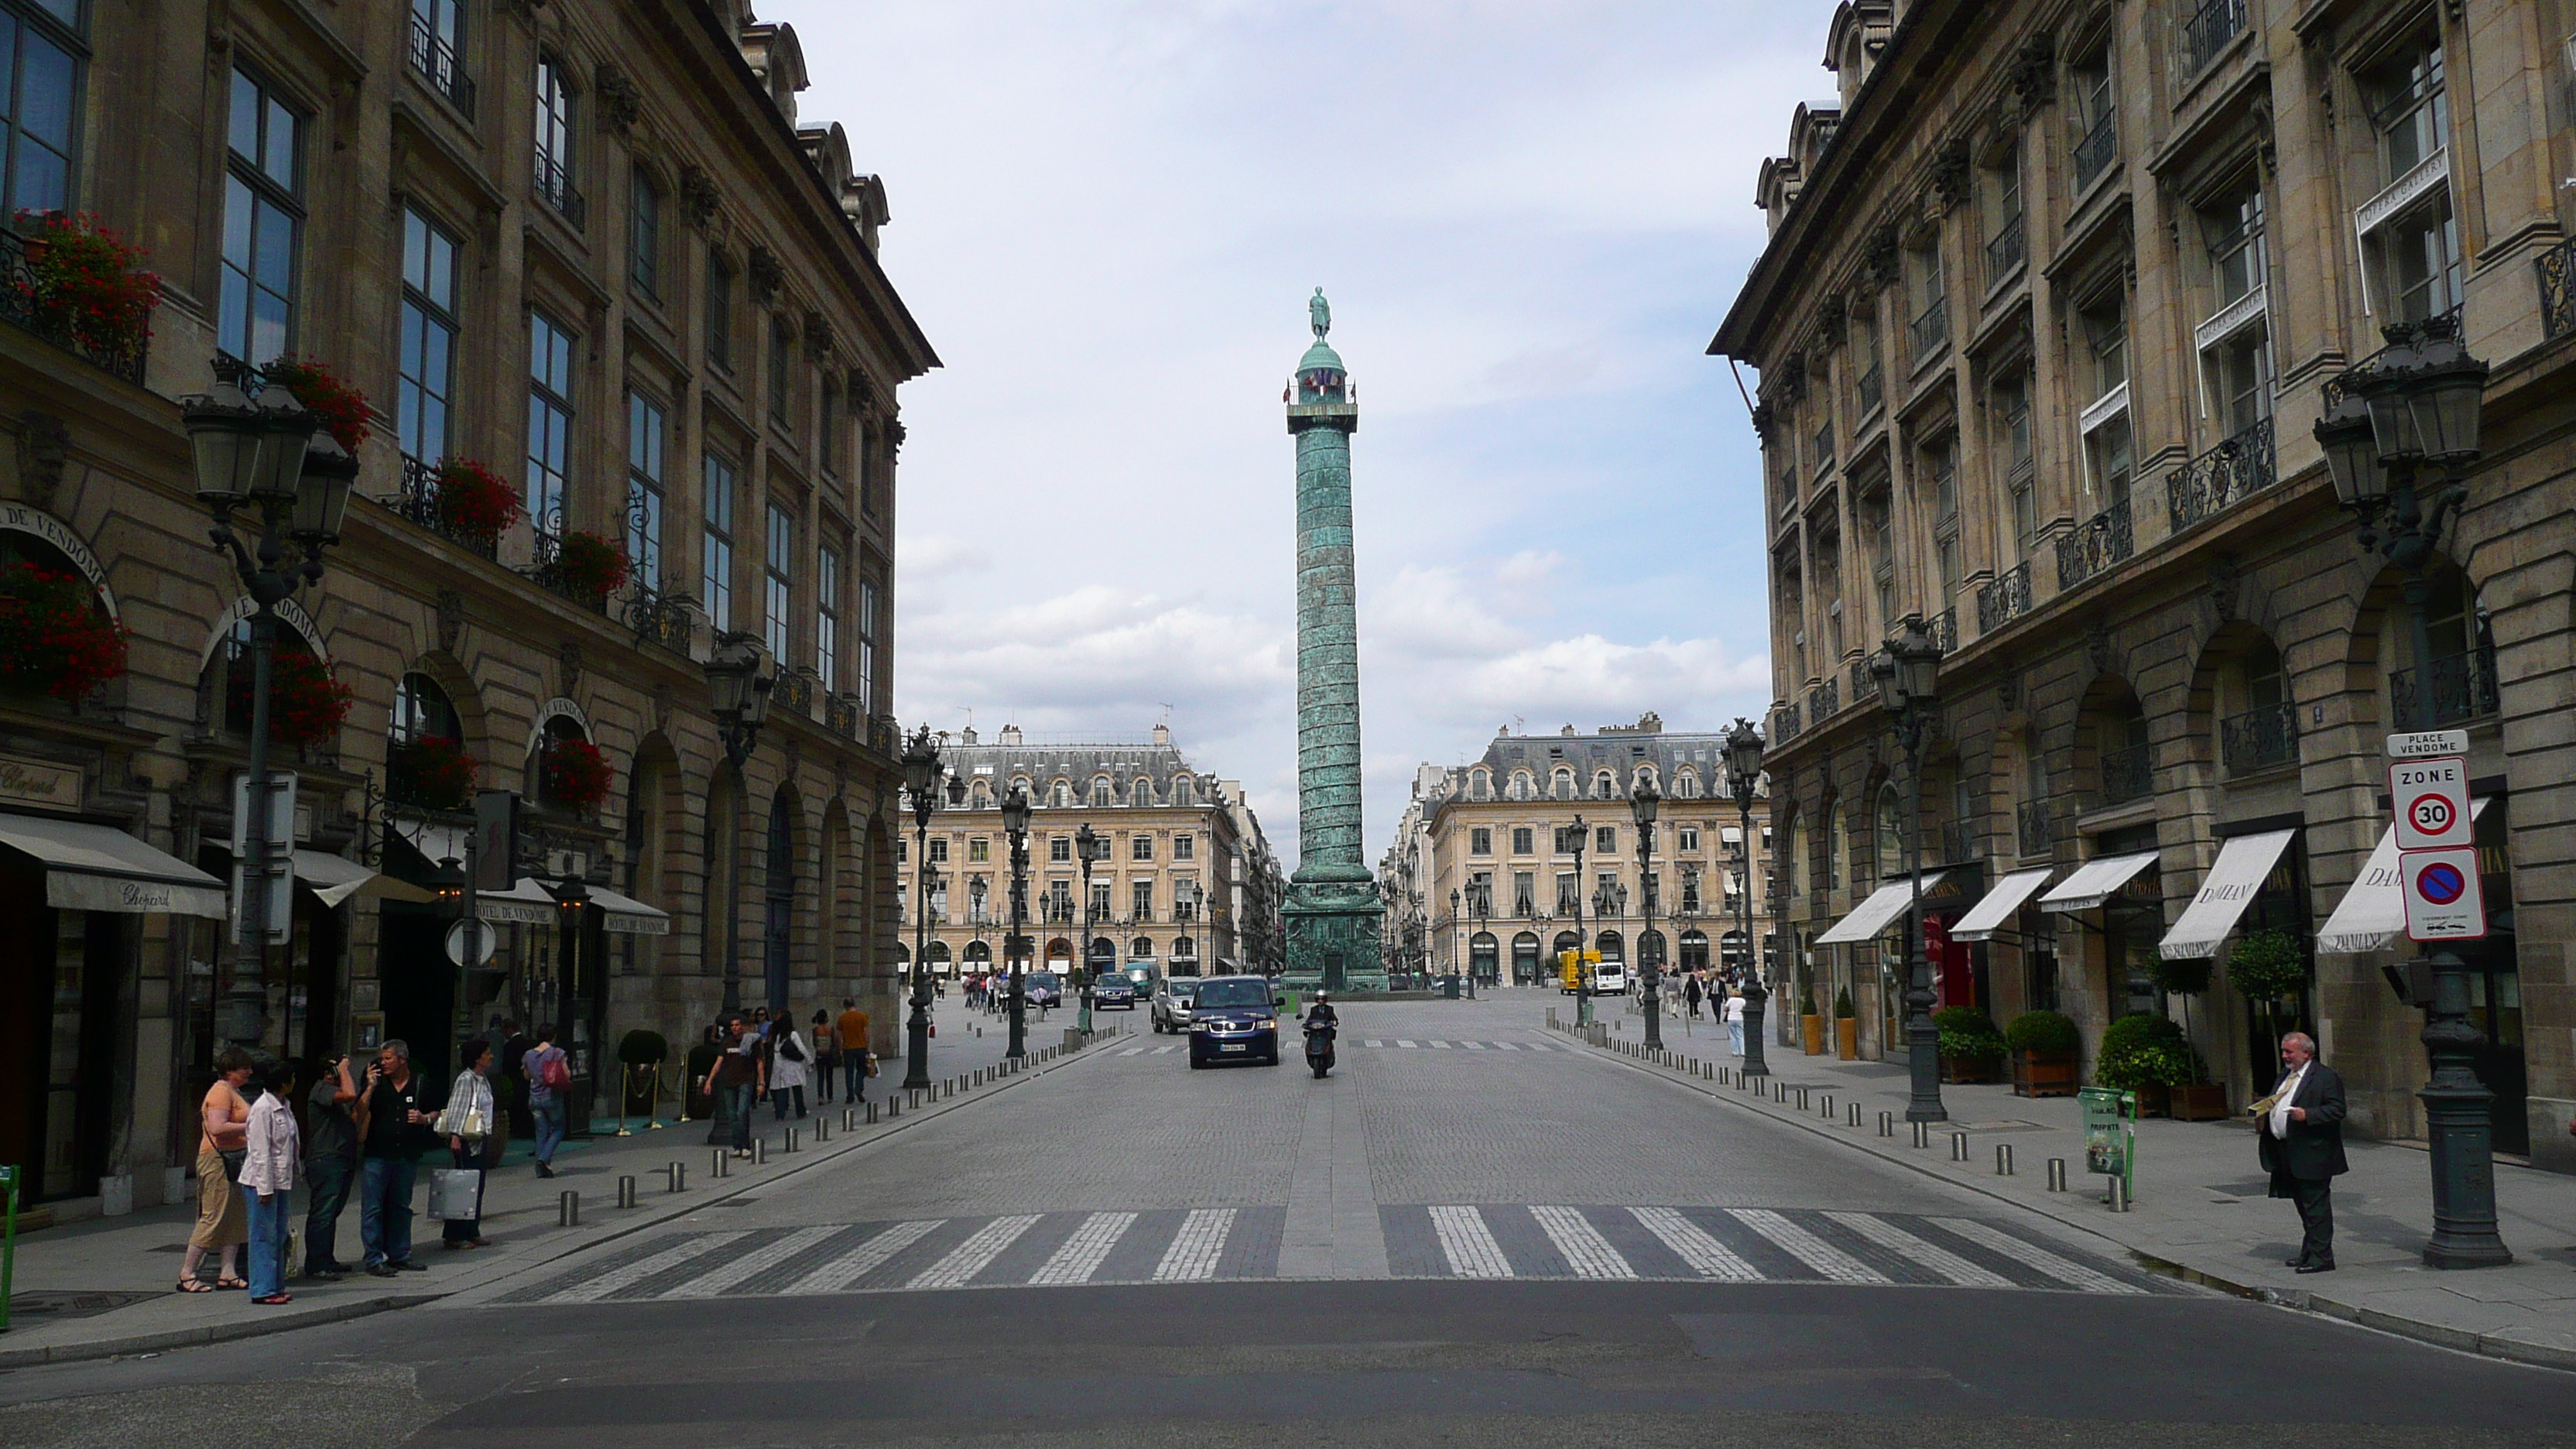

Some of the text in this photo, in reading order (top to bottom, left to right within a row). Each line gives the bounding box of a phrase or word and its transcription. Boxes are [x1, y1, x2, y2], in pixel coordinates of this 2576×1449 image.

[6, 507, 29, 526] DE
[232, 598, 251, 619] LE
[2400, 742, 2457, 753] VENDOME
[2409, 734, 2444, 744] PLACE
[2401, 769, 2454, 785] ZONE
[2418, 805, 2447, 824] 30
[118, 882, 170, 911] Chopard
[502, 906, 513, 919] DE
